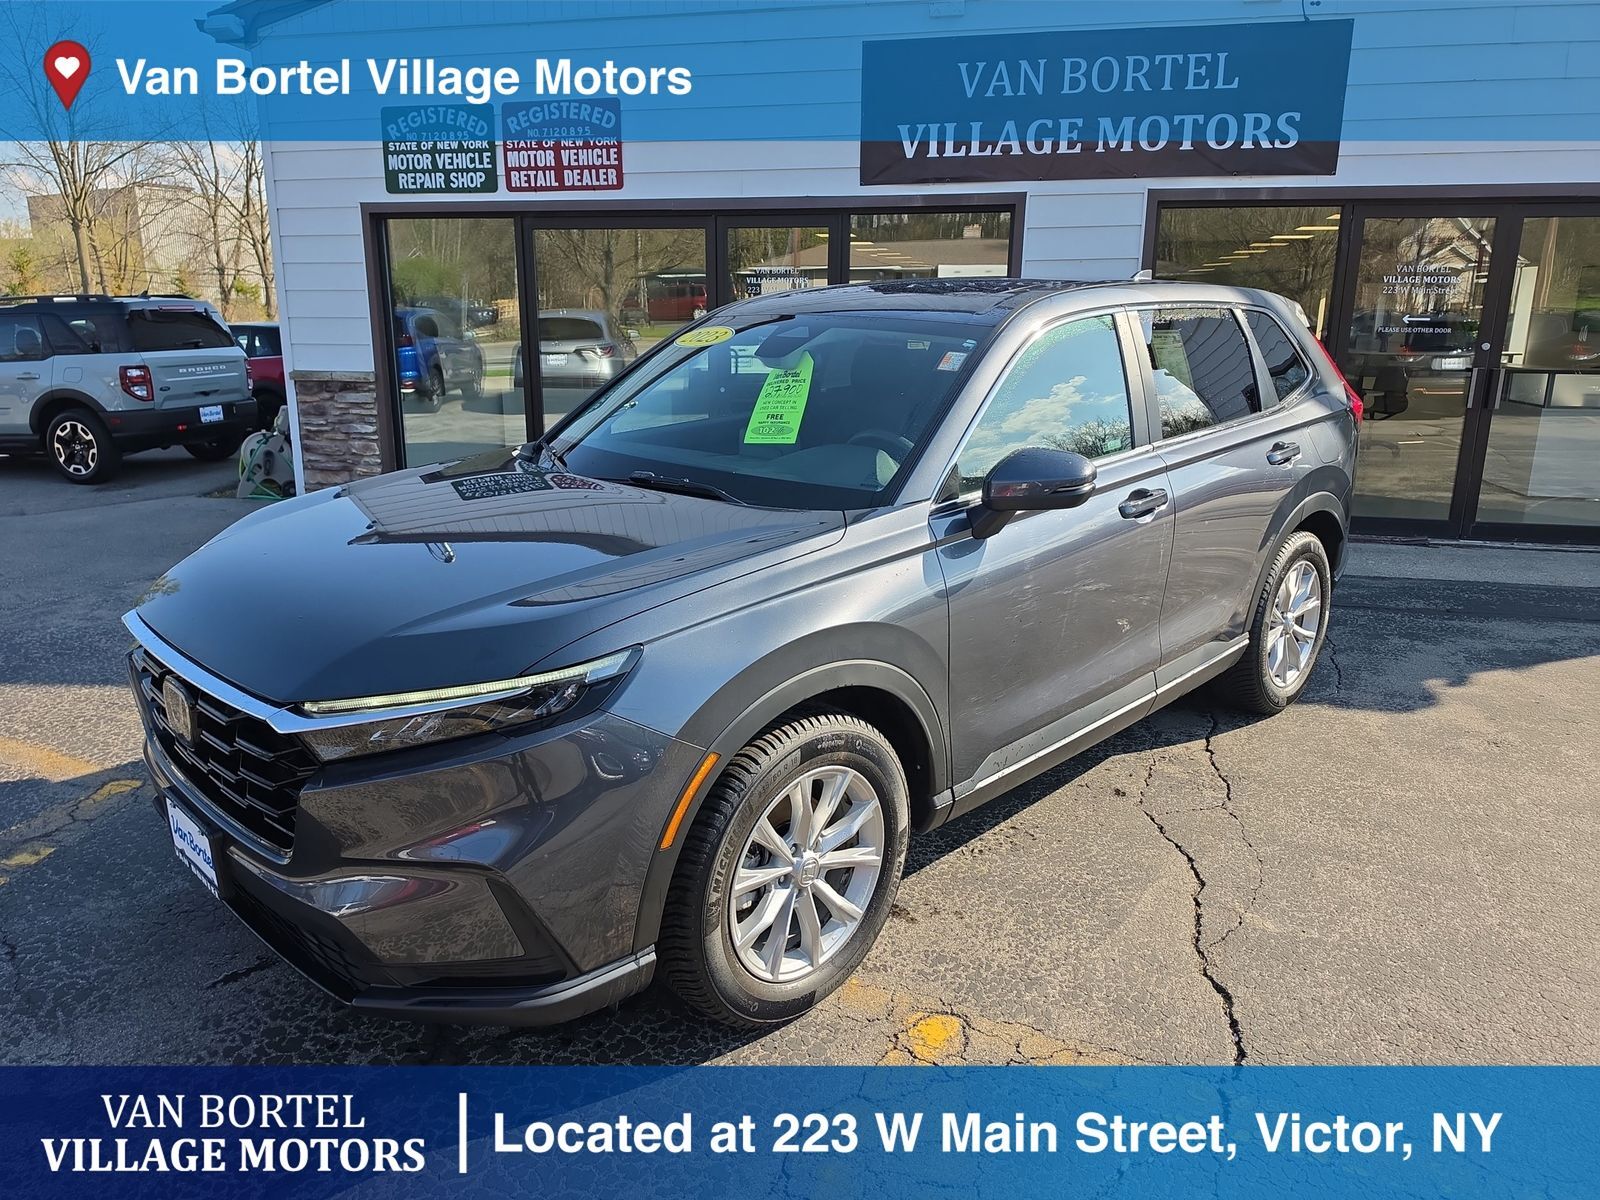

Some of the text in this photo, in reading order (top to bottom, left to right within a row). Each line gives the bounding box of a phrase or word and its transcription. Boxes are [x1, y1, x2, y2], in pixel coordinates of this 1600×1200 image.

[957, 52, 1239, 98] VAN BORTEL
[387, 107, 487, 140] REGISTERED
[507, 102, 616, 134] REGISTERED
[506, 137, 618, 149] STATE OF NEW YORK
[897, 112, 1301, 159] VILLAGE MOTORS
[388, 140, 489, 151] STATE OF NEW YORK
[388, 152, 492, 170] MOTOR VEHICLE
[507, 148, 619, 168] MOTOR VEHICLE
[398, 172, 486, 189] REPAIR SHOP
[510, 168, 617, 187] RETAIL DEALER
[1396, 264, 1451, 273] VAN BORTEL
[746, 276, 809, 284] VILLAGE MOTORS
[1383, 275, 1461, 284] VILLAGE MOTORS
[747, 286, 760, 294] 223
[1382, 286, 1398, 294] 223
[1400, 286, 1410, 294] W
[1411, 286, 1431, 294] Main
